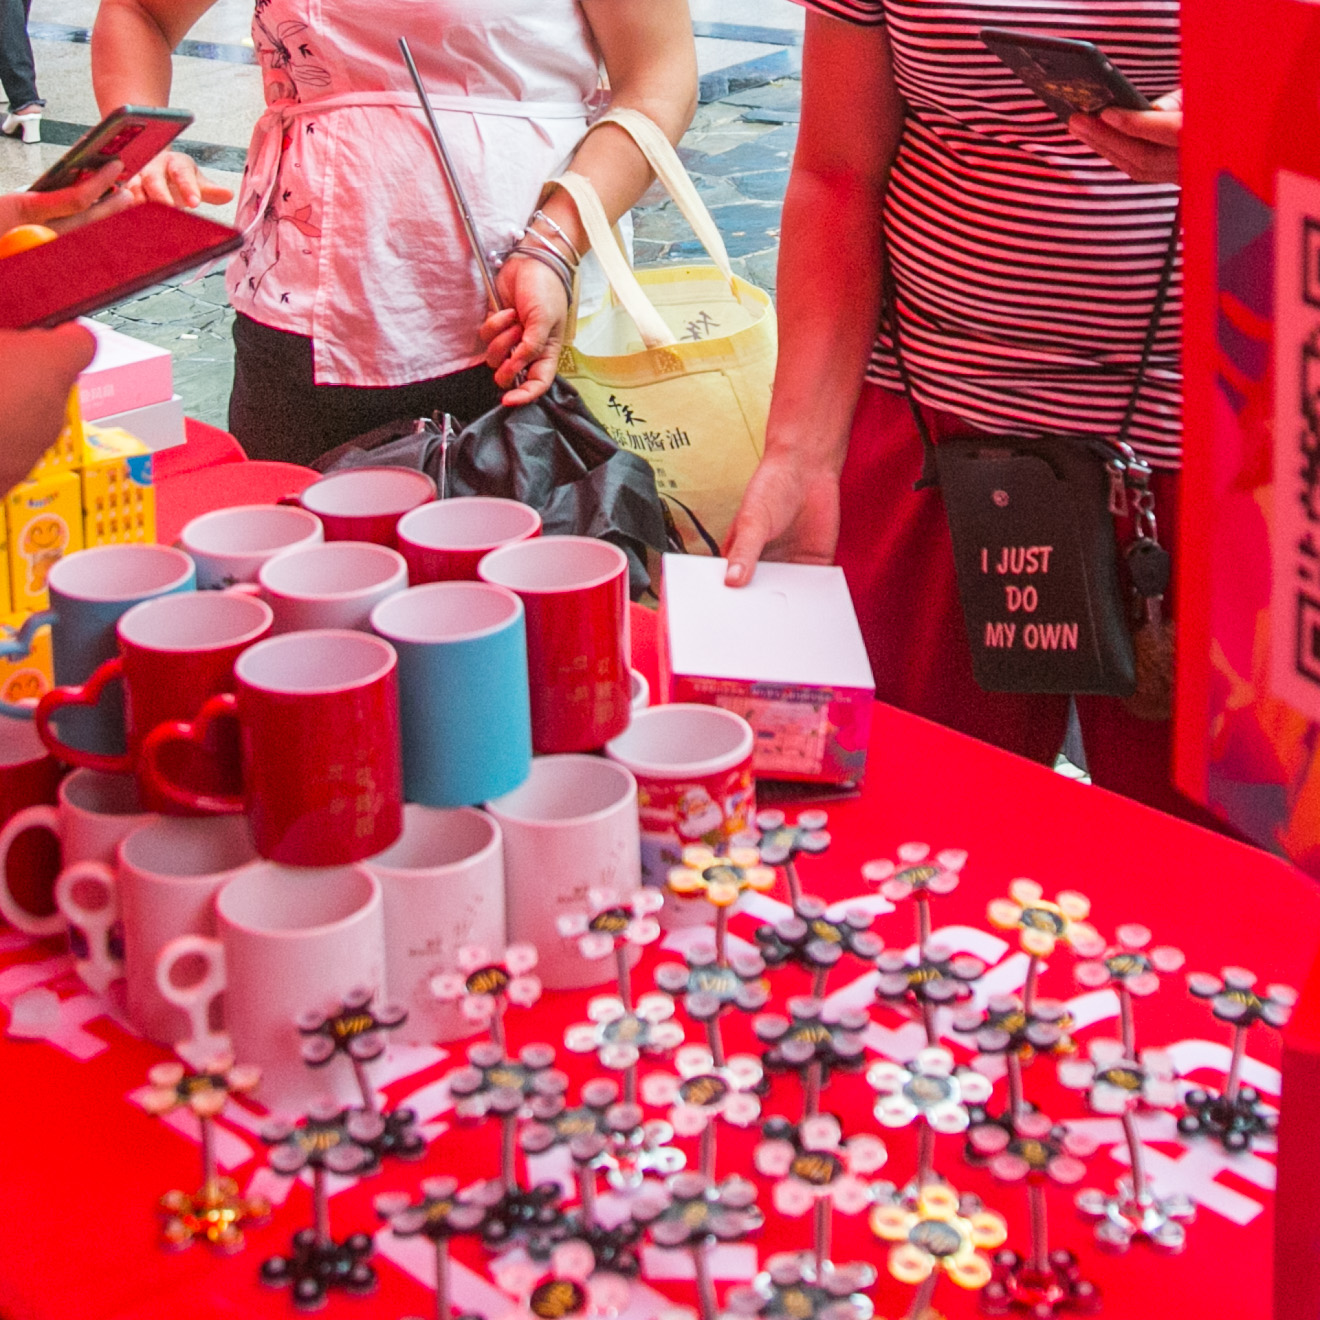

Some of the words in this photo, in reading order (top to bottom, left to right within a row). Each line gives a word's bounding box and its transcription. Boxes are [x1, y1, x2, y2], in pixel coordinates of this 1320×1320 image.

[981, 547, 988, 574] I
[996, 546, 1053, 575] JUST
[1005, 585, 1038, 613] DO
[984, 622, 1016, 649] MY
[1023, 623, 1079, 650] OWN
[335, 1012, 374, 1036] VIP
